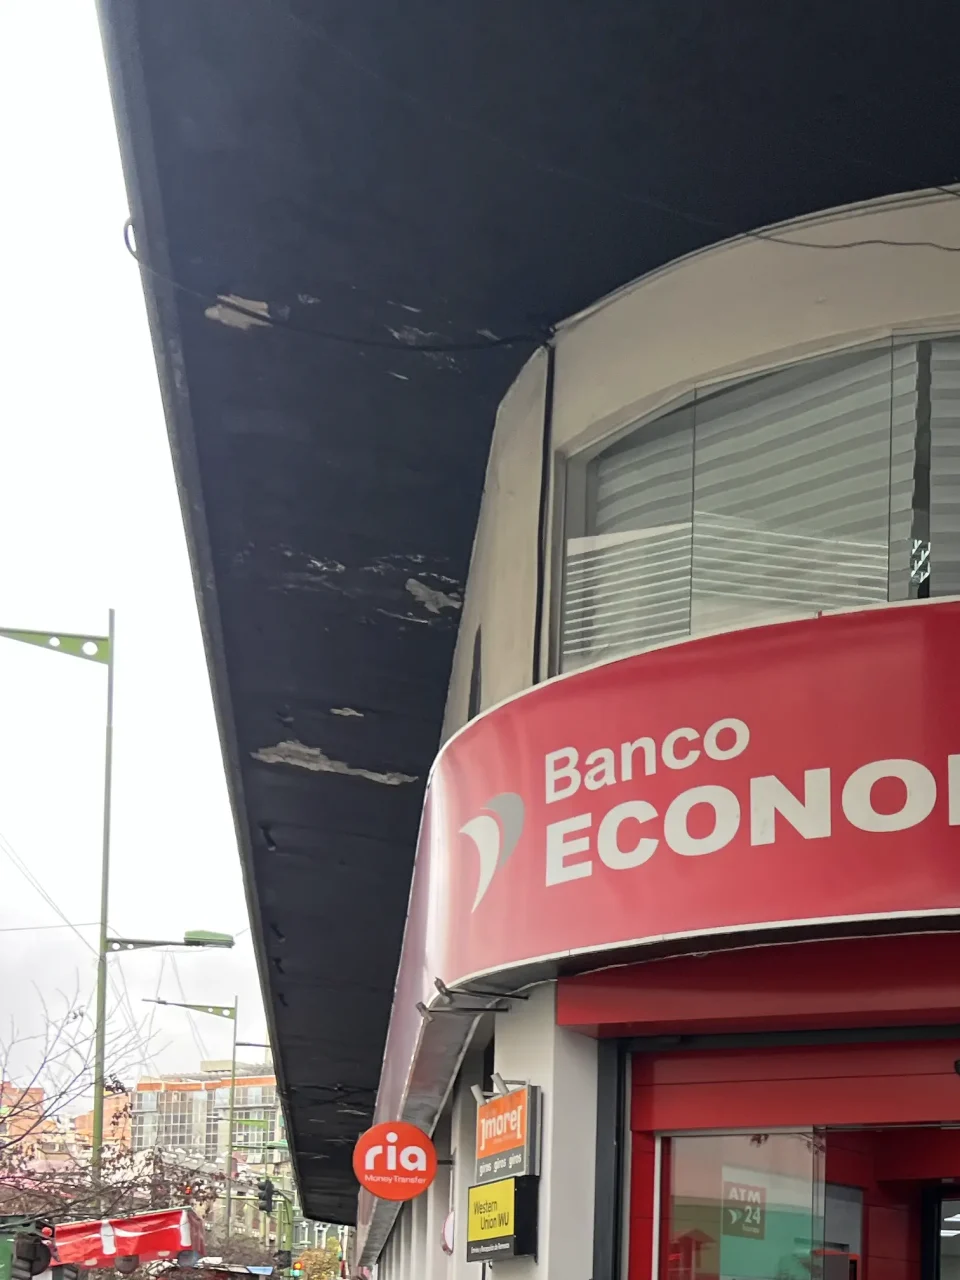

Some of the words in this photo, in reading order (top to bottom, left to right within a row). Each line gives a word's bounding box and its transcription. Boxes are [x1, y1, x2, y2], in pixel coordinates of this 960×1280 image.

[544, 717, 750, 804] Banco
[365, 1131, 427, 1172] ria
[365, 1174, 393, 1185] Money
[394, 1175, 427, 1185] Transfer
[728, 1187, 761, 1204] ATM
[473, 1200, 498, 1215] Western
[744, 1205, 761, 1225] 24
[480, 1214, 497, 1231] Union
